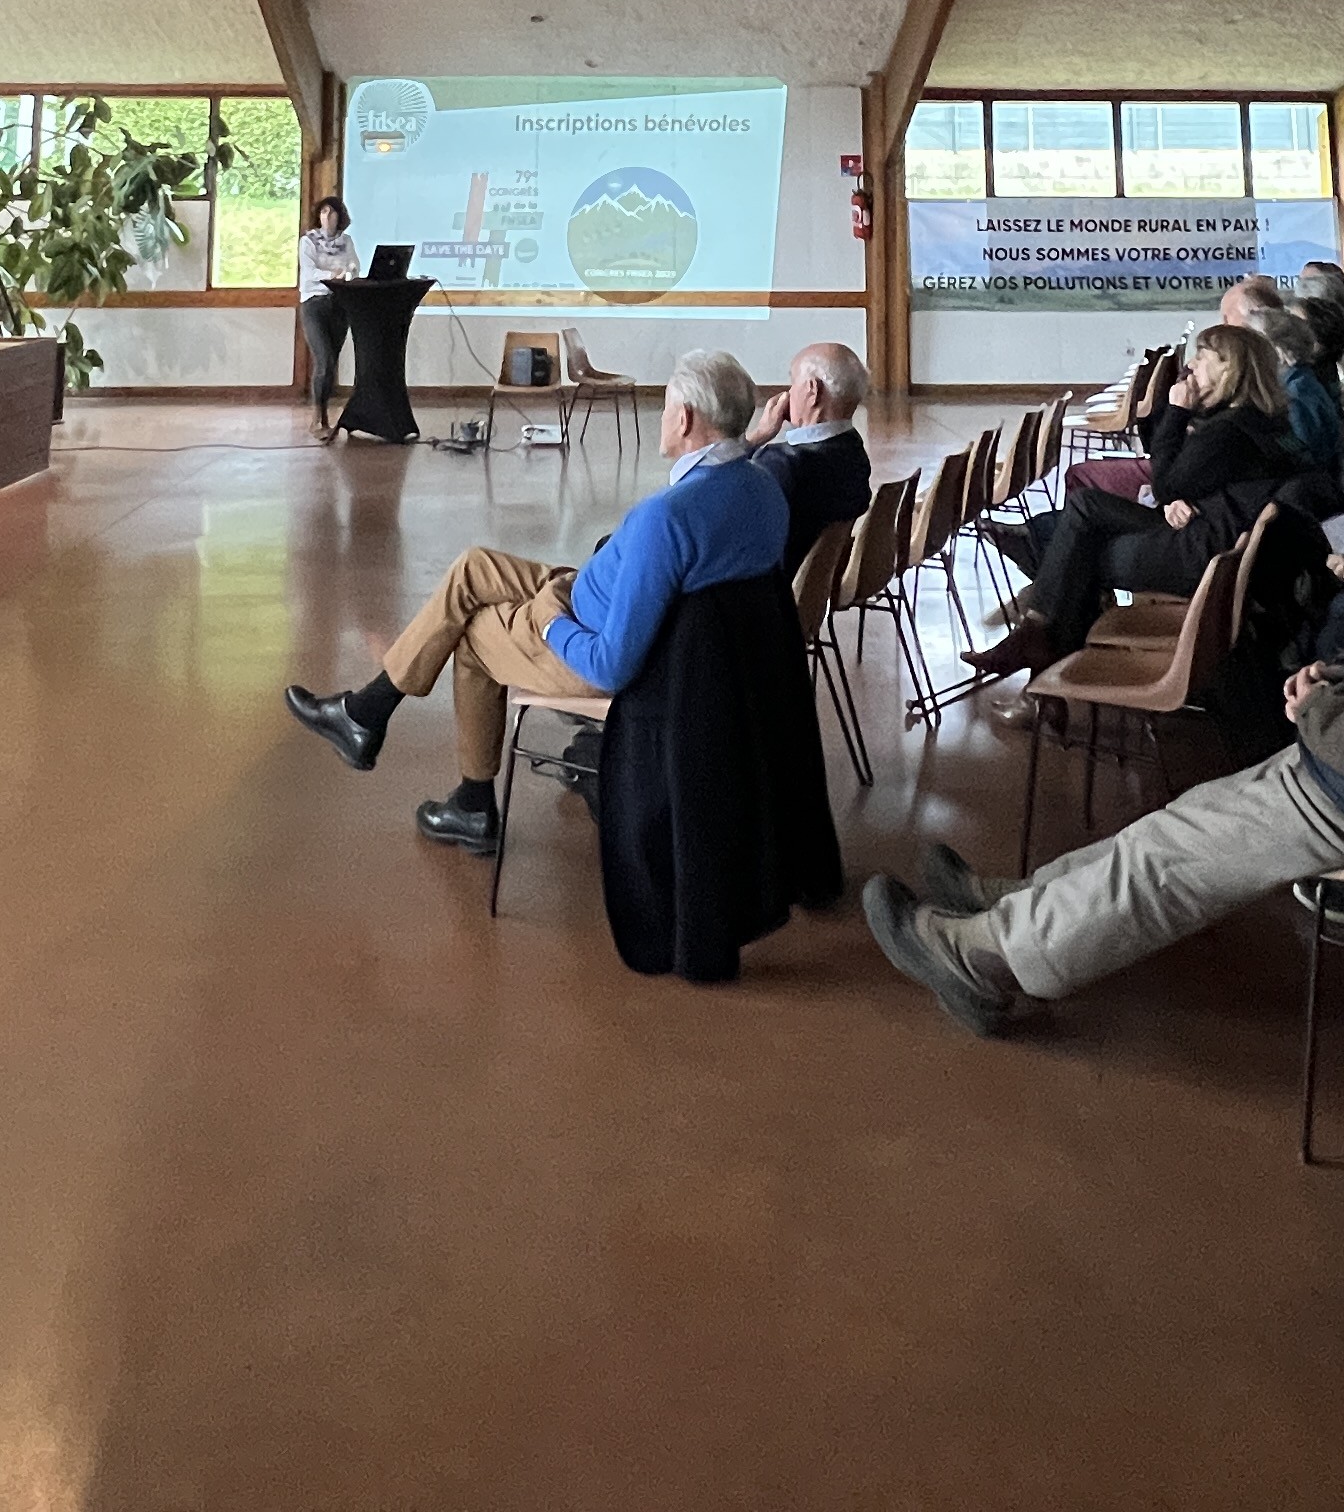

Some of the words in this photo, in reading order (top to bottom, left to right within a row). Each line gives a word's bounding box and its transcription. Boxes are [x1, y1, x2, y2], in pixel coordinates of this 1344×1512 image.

[515, 112, 637, 135] Inscriptions
[644, 114, 751, 132] bénévoles
[976, 219, 1042, 232] LAISSEZ
[1047, 219, 1065, 232] LE
[1069, 219, 1132, 233] MONDE
[1137, 219, 1192, 232] RURAL
[1196, 219, 1217, 232] EN
[1223, 219, 1260, 232] PAIX
[1265, 218, 1270, 231] !
[982, 248, 1031, 261] NOUS
[1036, 247, 1110, 262] SOMMES
[1116, 247, 1171, 262] VOTRE
[1176, 244, 1256, 261] OXYGÈNE
[1260, 246, 1266, 260] !
[923, 273, 976, 289] GÉREZ
[981, 276, 1018, 289] VOS
[1024, 275, 1128, 290] POLLUTIONS
[1133, 276, 1151, 289] ET
[1156, 275, 1213, 289] VOTRE
